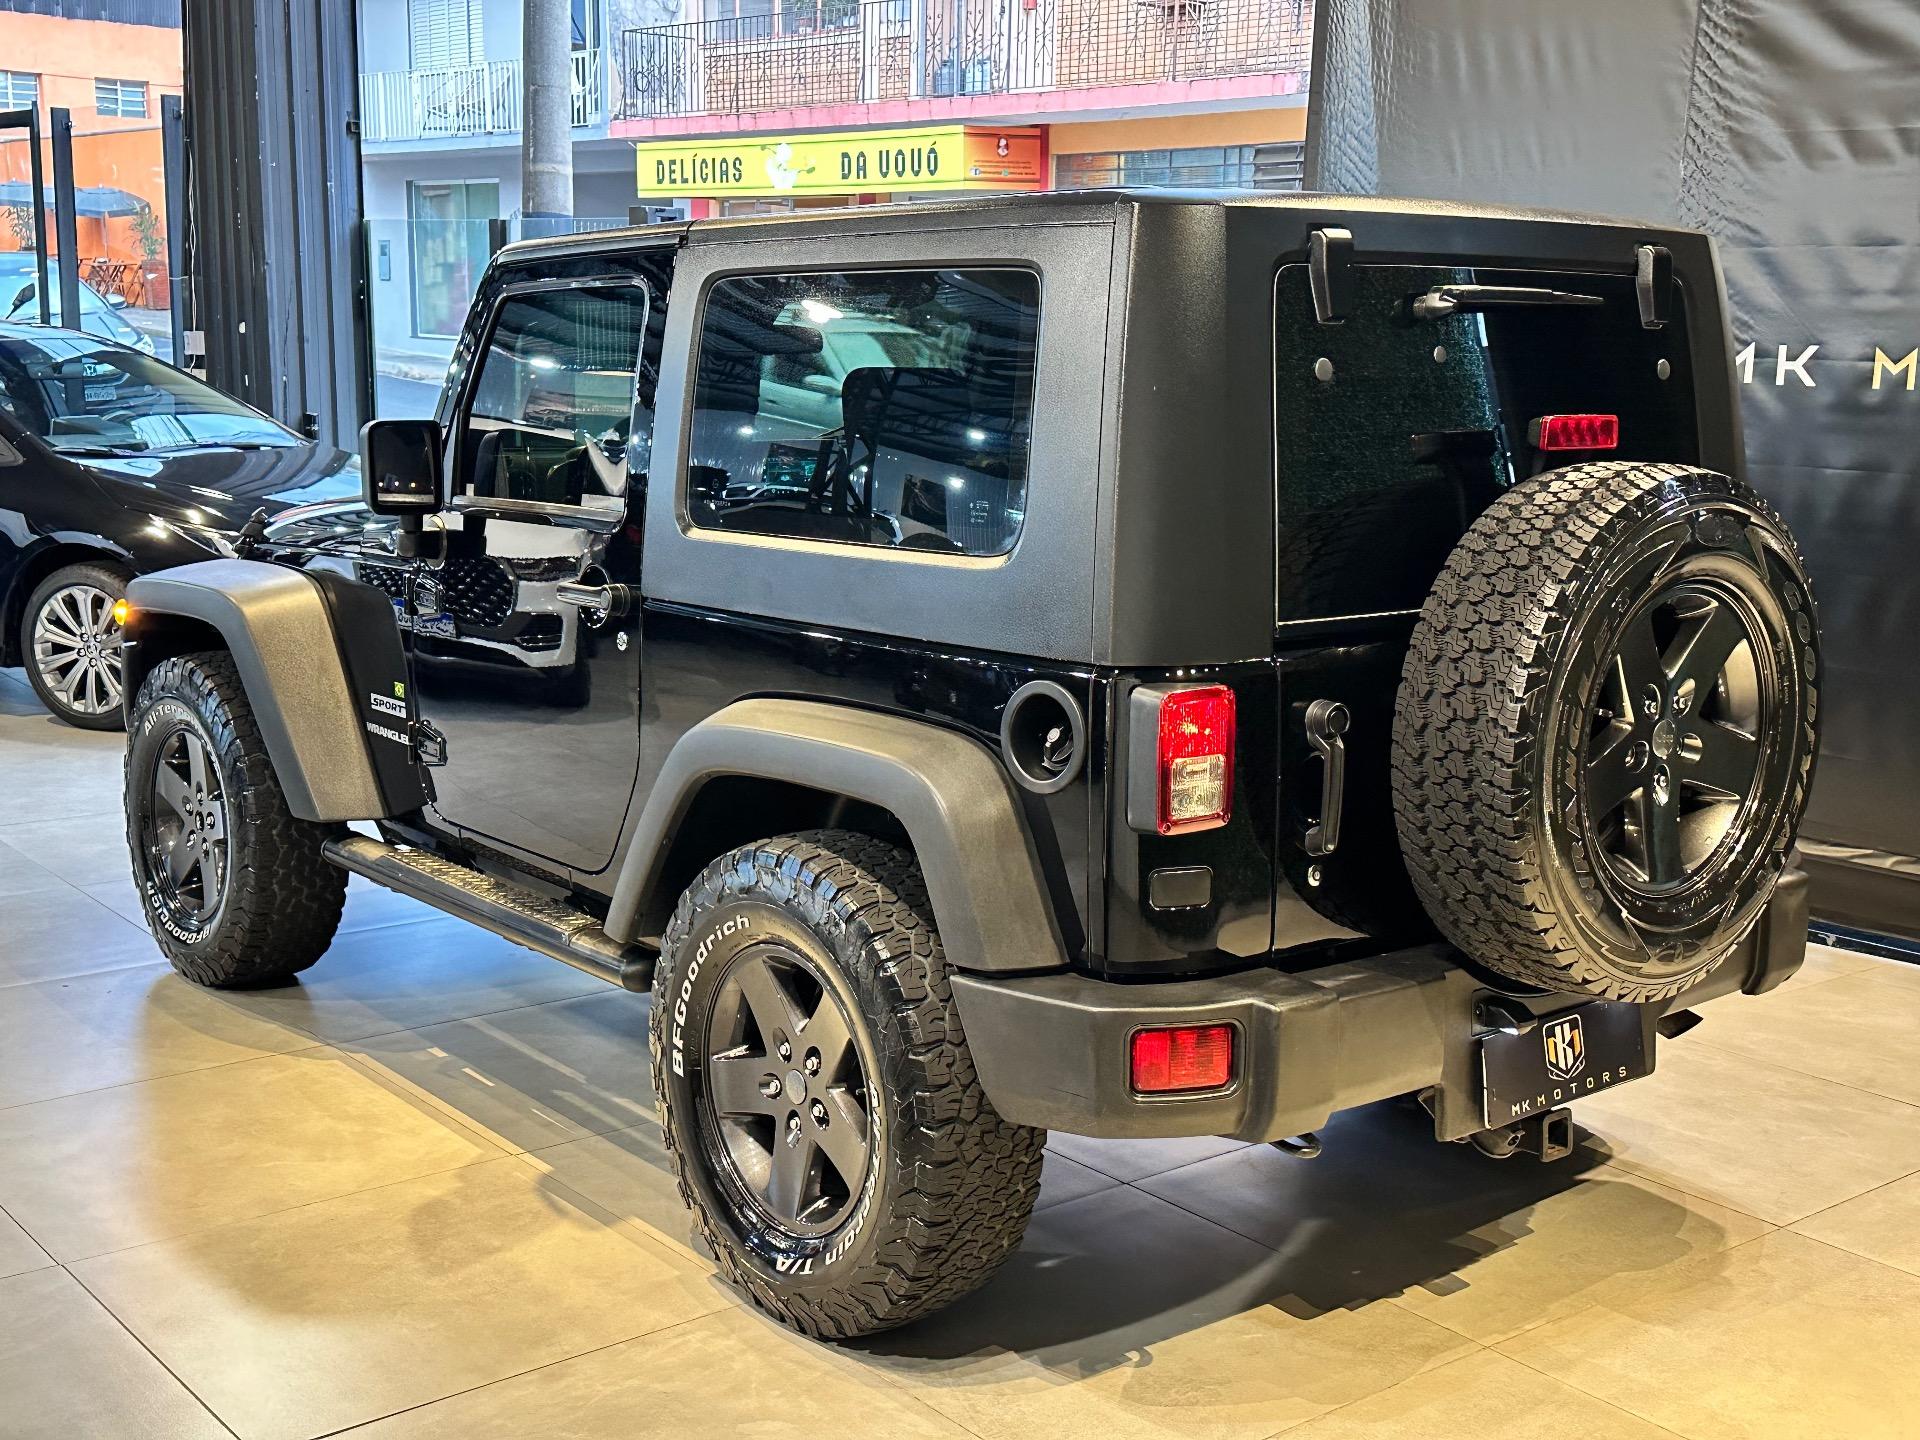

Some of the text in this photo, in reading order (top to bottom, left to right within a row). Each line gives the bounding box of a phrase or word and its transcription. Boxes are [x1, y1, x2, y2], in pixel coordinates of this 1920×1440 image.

[656, 153, 743, 184] DELÍCIAS
[841, 151, 867, 180] DA
[371, 697, 407, 714] SPORT
[366, 721, 409, 746] WRANGLE
[146, 881, 212, 945] BFGoodrich
[672, 914, 751, 1078] BFGoodrich
[1511, 1066, 1628, 1117] MK MOTORS
[775, 1079, 881, 1275] All-Terrain T/A
